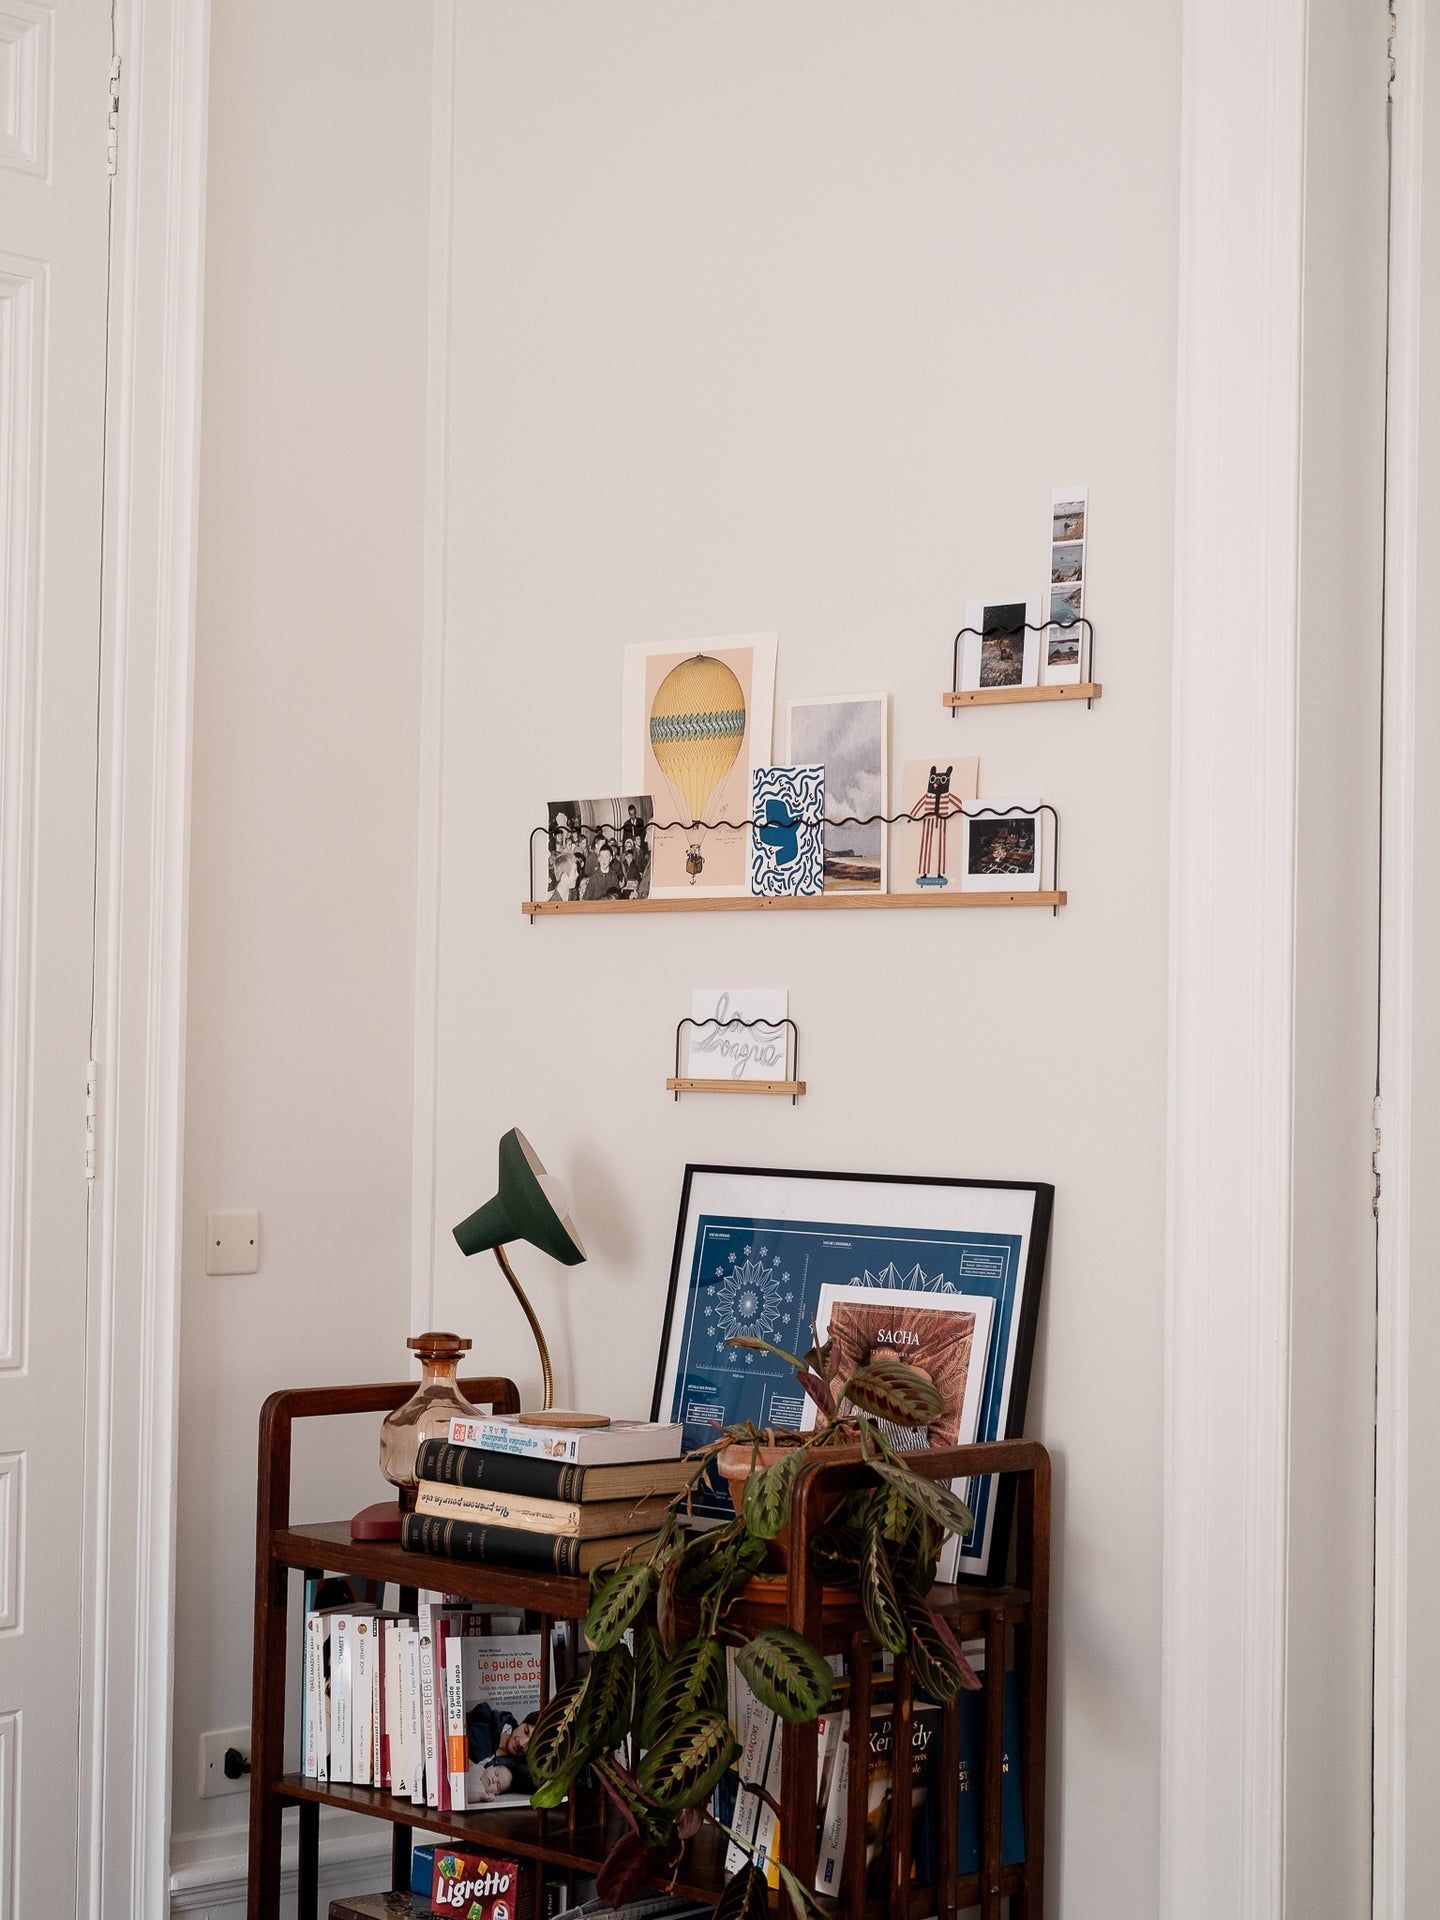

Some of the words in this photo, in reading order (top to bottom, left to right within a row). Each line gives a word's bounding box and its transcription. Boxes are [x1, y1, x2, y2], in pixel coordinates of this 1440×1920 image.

[877, 1328, 921, 1346] SACHA
[483, 1425, 488, 1433] Z
[494, 1426, 499, 1434] A
[500, 1427, 508, 1435] de
[482, 1433, 508, 1443] questions
[509, 1436, 532, 1447] grandes
[421, 1493, 434, 1503] vie
[463, 1500, 495, 1512] prénom
[422, 1654, 431, 1675] BIO
[477, 1659, 489, 1670] Le
[492, 1658, 523, 1671] guide
[527, 1657, 541, 1668] du
[481, 1671, 510, 1684] jeune
[514, 1671, 541, 1682] papa
[422, 1678, 432, 1705] BÉBÉ
[450, 1709, 455, 1719] Le
[455, 1709, 461, 1719] du
[747, 1724, 759, 1761] GARÇONS
[868, 1723, 933, 1752] Kendy
[831, 1816, 843, 1850] Kennedy
[435, 1871, 510, 1908] Ligretto
